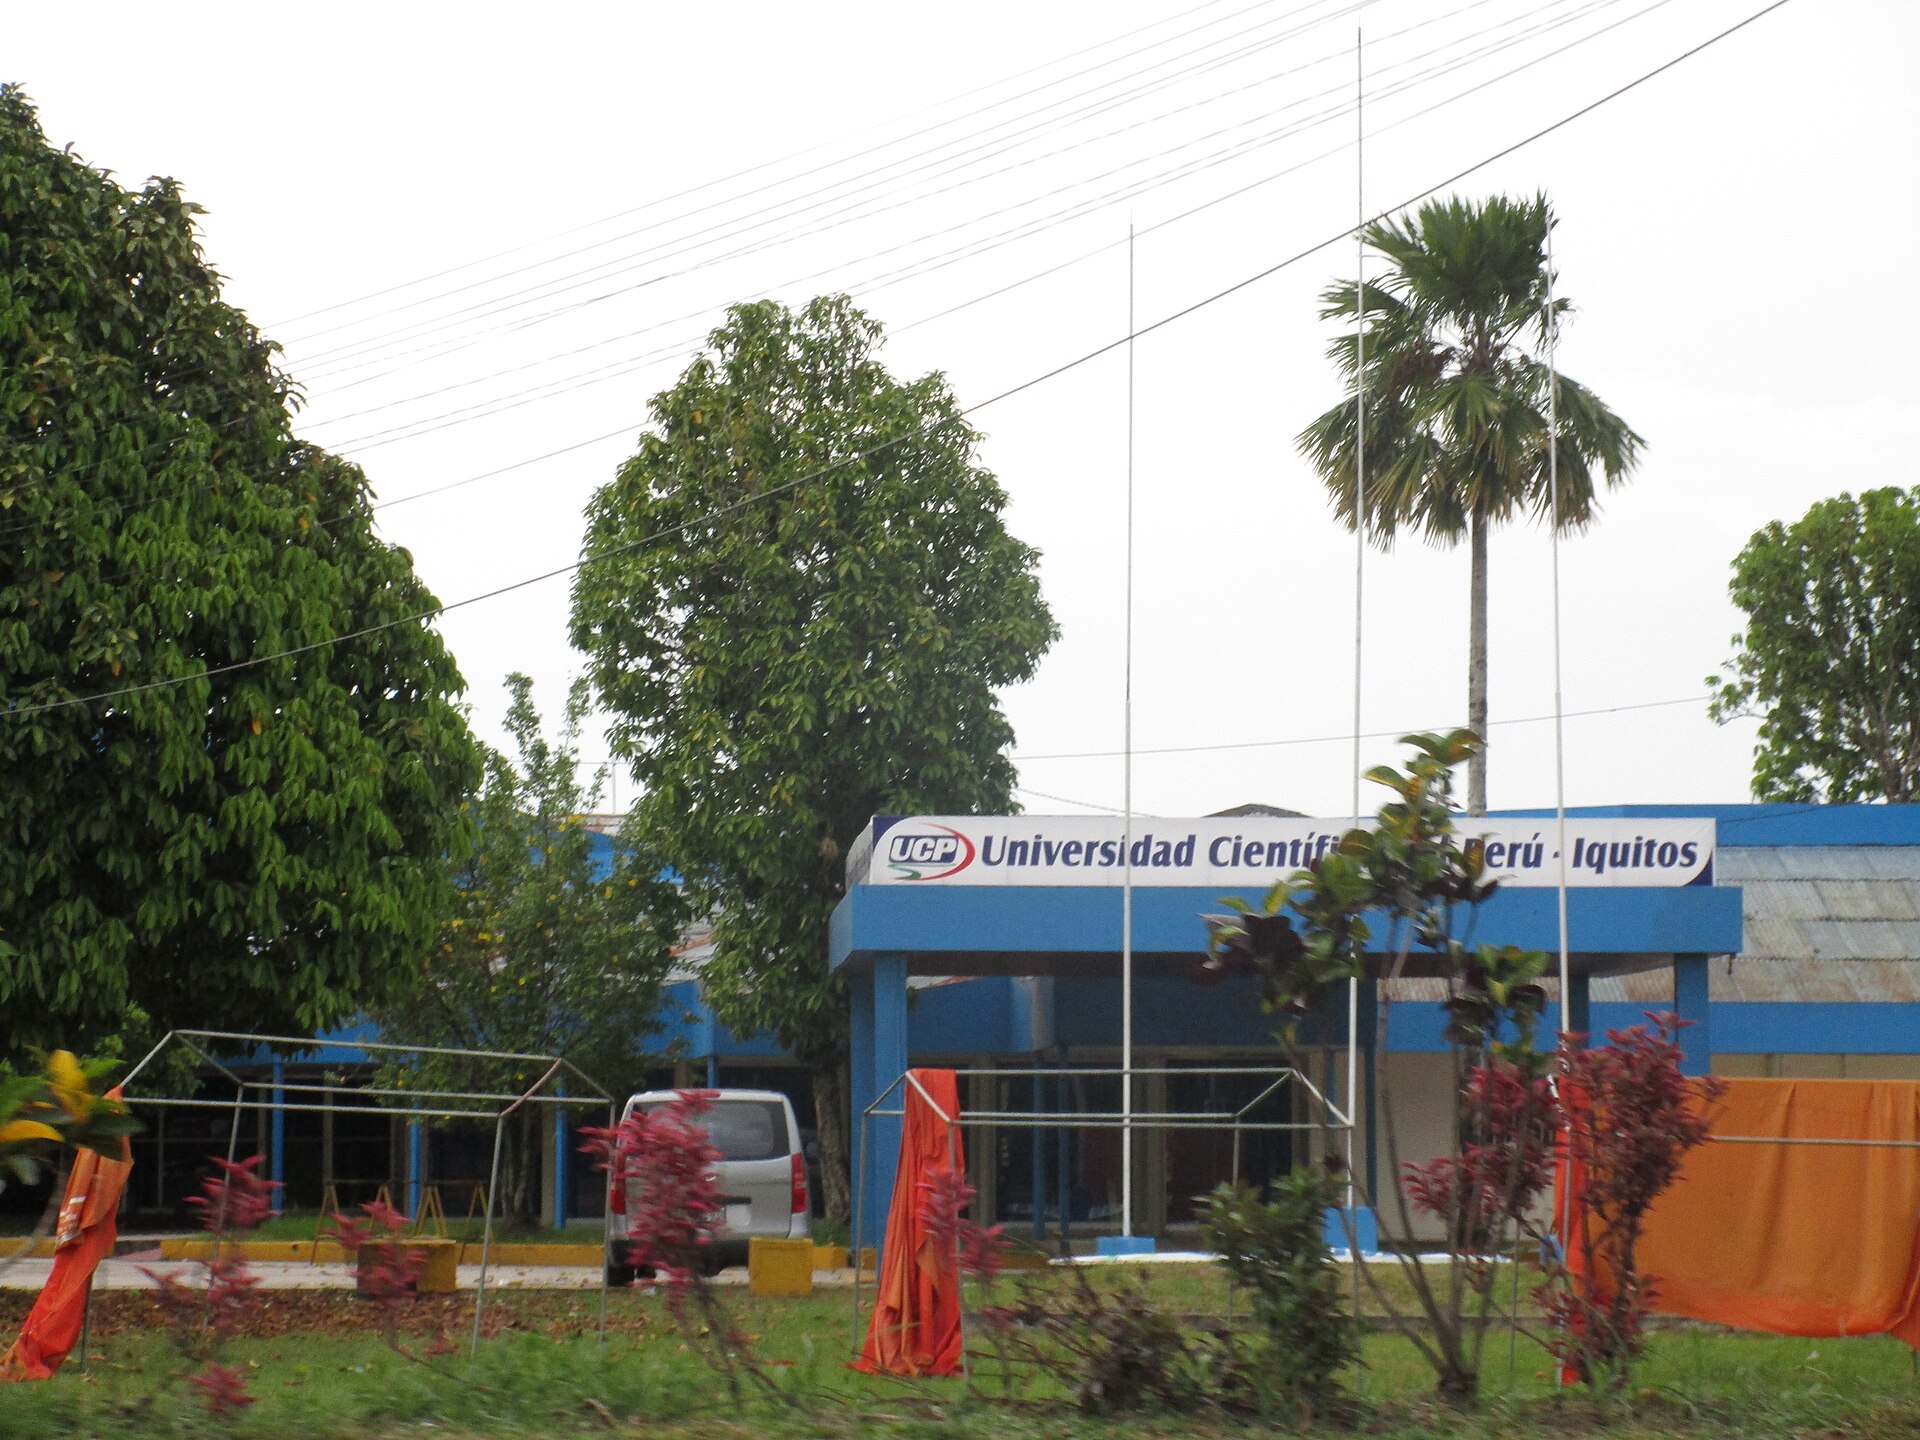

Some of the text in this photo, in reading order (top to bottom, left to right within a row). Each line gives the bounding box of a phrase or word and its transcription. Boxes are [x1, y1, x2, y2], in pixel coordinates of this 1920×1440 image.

[890, 837, 956, 862] UCP
[981, 834, 1197, 867] Universidad
[1572, 836, 1698, 874] Iquitos
